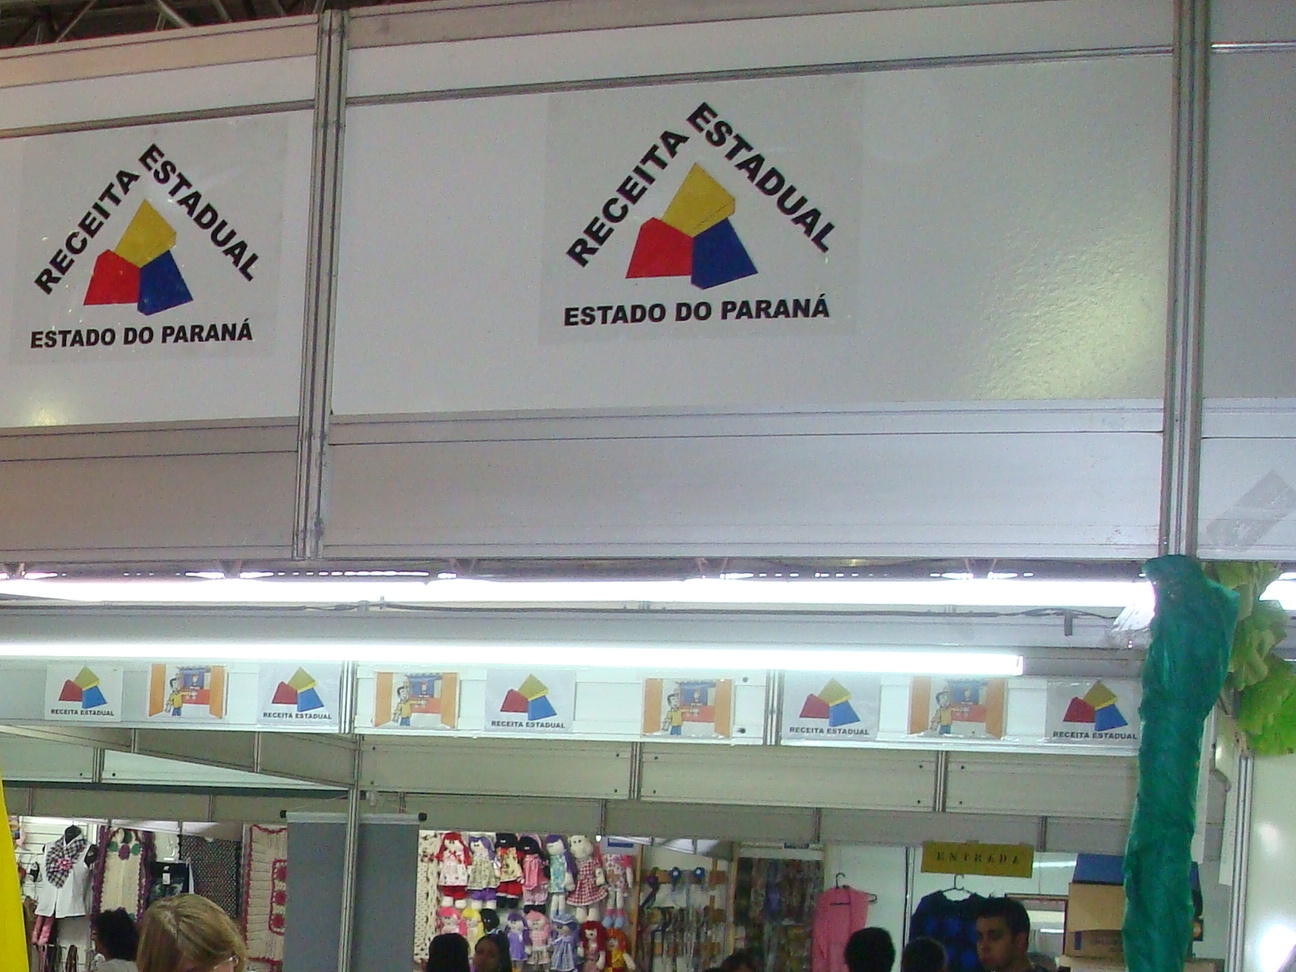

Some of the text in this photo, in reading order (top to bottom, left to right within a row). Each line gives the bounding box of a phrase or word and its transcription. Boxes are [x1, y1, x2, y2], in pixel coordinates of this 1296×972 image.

[34, 143, 259, 295] RECEITA ESTADUAL
[566, 102, 835, 268] RECEITA ESTADUAL
[31, 318, 252, 348] ESTADO DO PARANÁ
[564, 294, 829, 326] ESTADO DO PARANÁ
